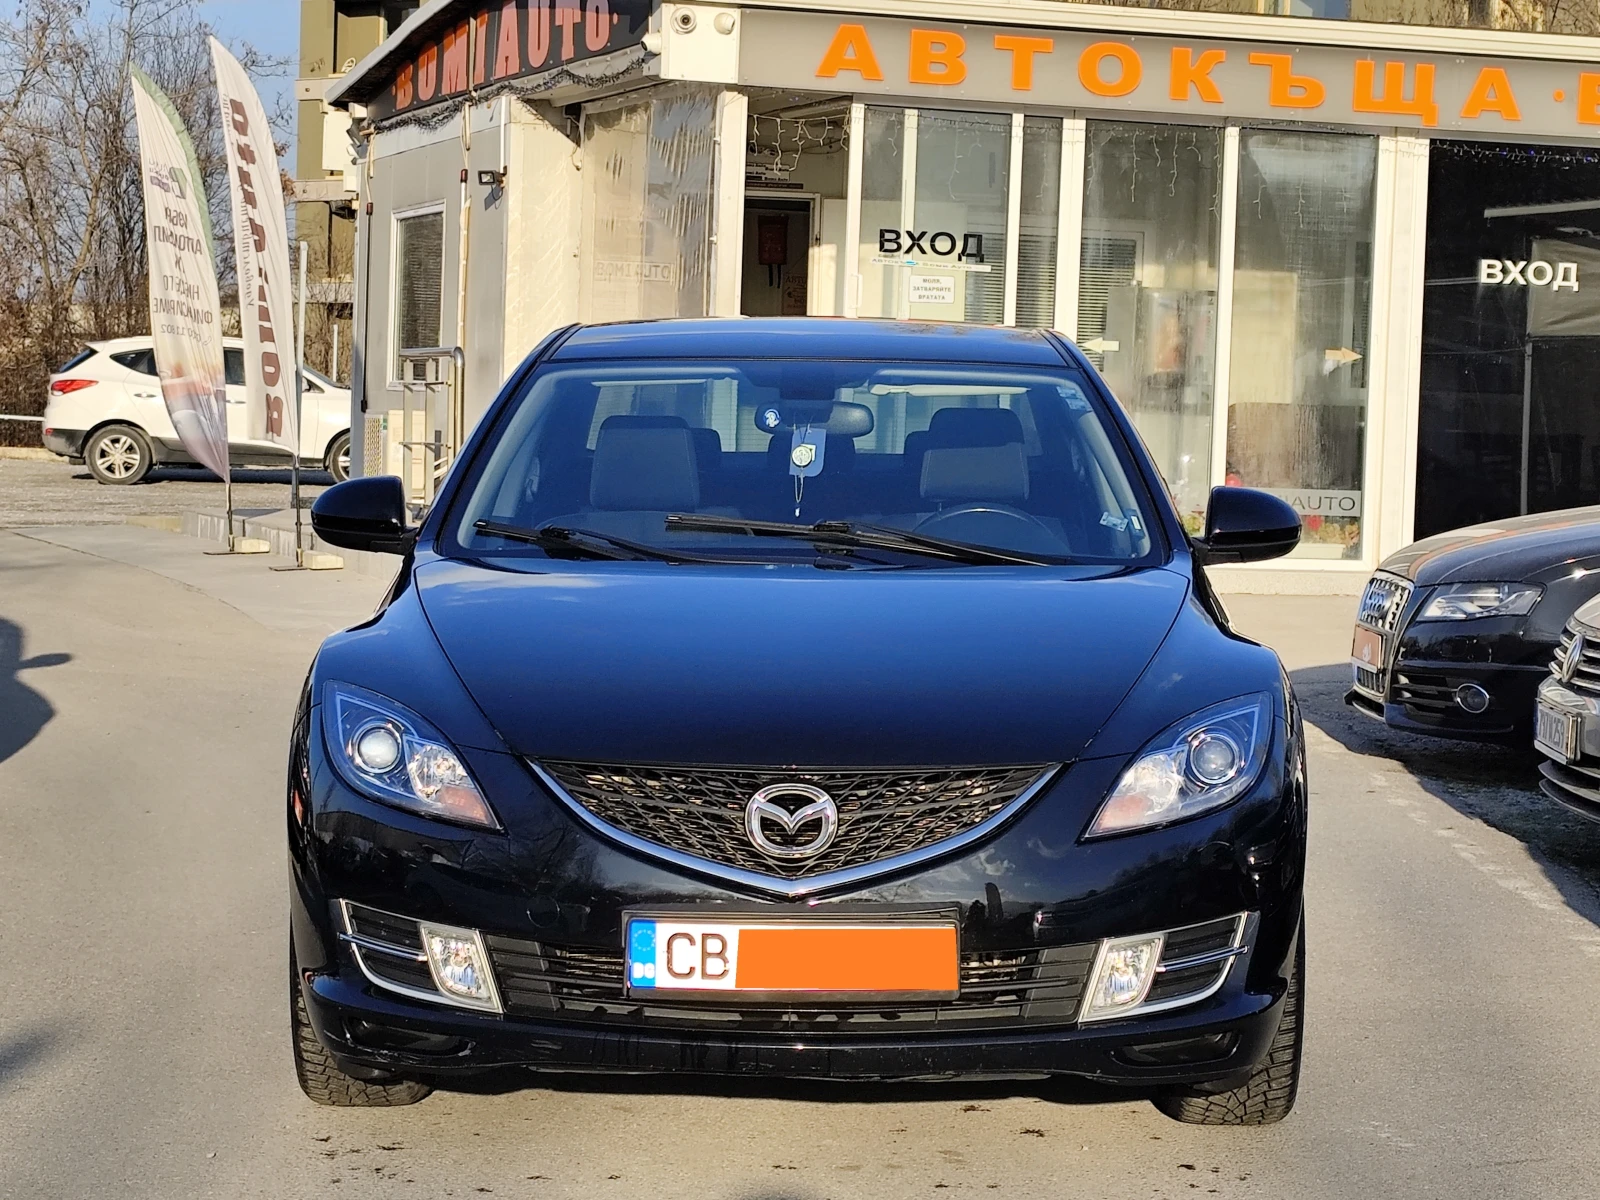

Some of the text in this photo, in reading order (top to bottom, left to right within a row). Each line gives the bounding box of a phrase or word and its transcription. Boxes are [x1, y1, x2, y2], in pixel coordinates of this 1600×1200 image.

[815, 23, 1522, 127] АВТОКЪЩА
[879, 228, 985, 263] ВХОД
[912, 285, 952, 293] ЗАТВАРЯЙТЕ
[1479, 259, 1580, 292] ВХОД
[666, 932, 730, 980] CB
